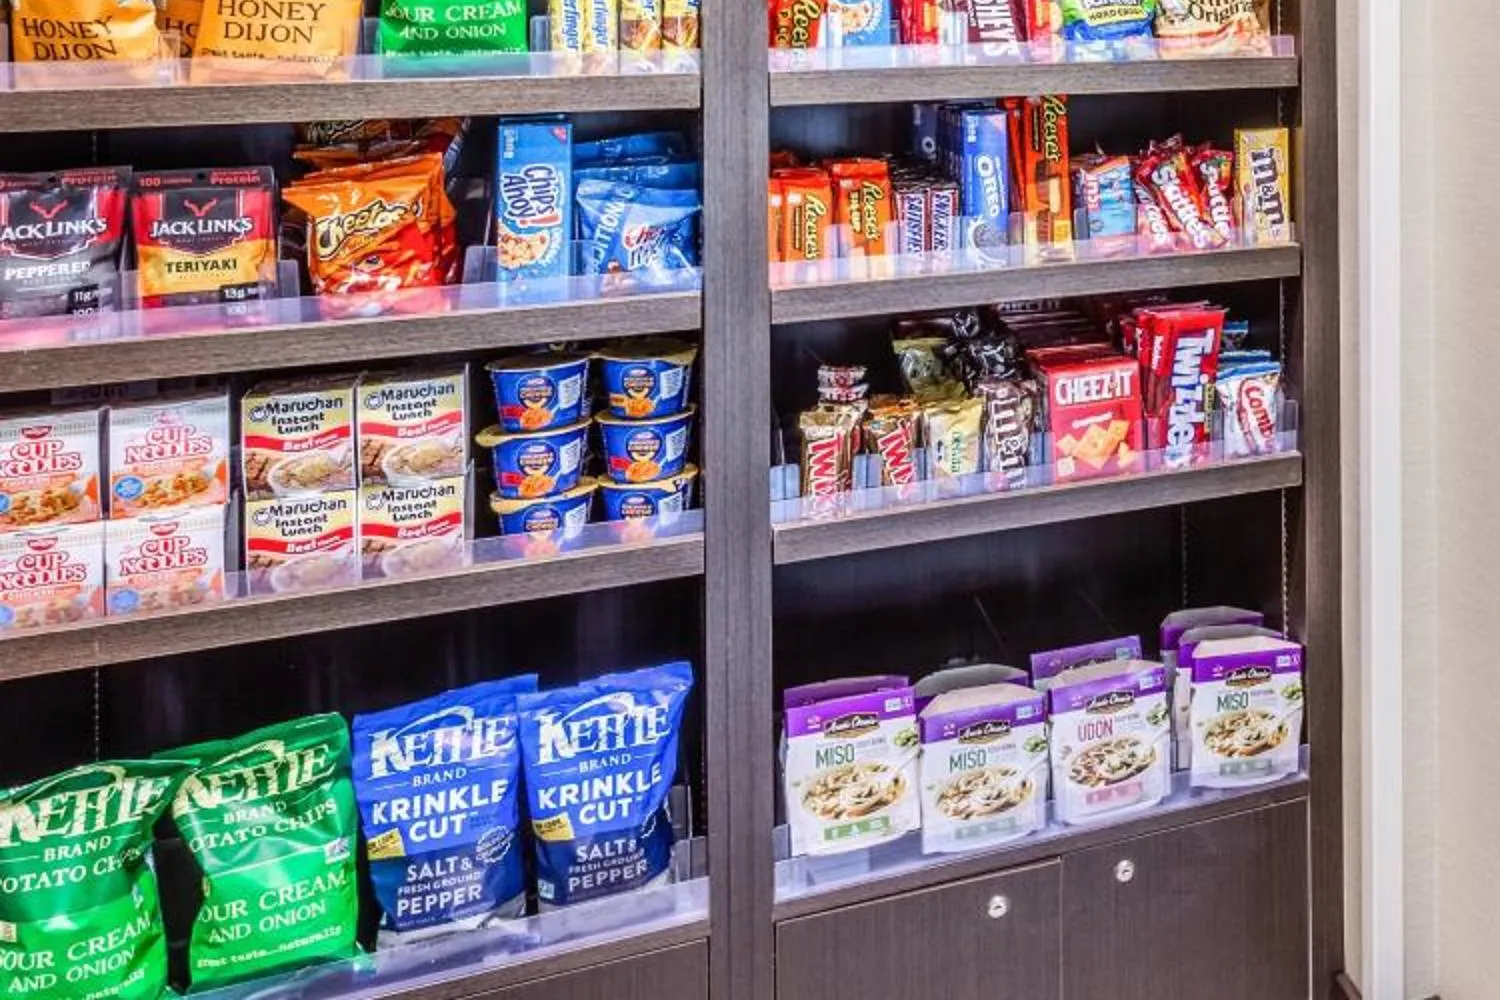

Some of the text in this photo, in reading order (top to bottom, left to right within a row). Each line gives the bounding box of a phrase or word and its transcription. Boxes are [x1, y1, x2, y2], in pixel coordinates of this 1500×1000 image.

[444, 0, 522, 21] CREAM
[22, 14, 114, 40] HONEY
[222, 21, 315, 45] DIJON
[399, 23, 508, 42] AND ONION
[33, 40, 118, 62] DIJON
[210, 173, 262, 186] Protein
[521, 163, 557, 217] Chips
[976, 154, 1000, 219] OREO
[861, 180, 885, 241] Reese's
[46, 216, 108, 237] LINK'S
[150, 216, 254, 238] JACK LINK'S
[805, 193, 827, 260] Reese's
[5, 261, 92, 281] PEPPERED
[164, 257, 238, 275] TERIYAKI
[381, 382, 456, 402] Maruchan
[1054, 369, 1133, 407] CHEEZ-IT
[266, 396, 344, 415] Maruchan
[384, 398, 438, 414] Instant
[391, 409, 433, 422] Lunch
[271, 410, 326, 426] Instant
[277, 423, 320, 436] Lunch
[145, 423, 196, 444] CUP
[11, 439, 63, 460] CUP
[124, 436, 213, 466] NOODLES
[381, 483, 456, 503] Maruchan
[268, 497, 347, 517] Maruchan
[386, 499, 438, 515] Instant
[392, 510, 433, 523] Lunch
[274, 513, 329, 529] Instant
[281, 525, 324, 538] Lunch
[140, 535, 191, 557] CUP
[16, 550, 69, 572] CUP
[119, 547, 209, 577] NOODLES
[1216, 691, 1249, 713] MISO
[534, 690, 674, 767] KETTLE
[1077, 717, 1114, 743] UDON
[367, 705, 517, 782] KETTLE
[578, 751, 633, 774] BRAND
[815, 743, 856, 769] MISO
[949, 749, 988, 773] MISO
[411, 765, 467, 788] BRAND
[537, 764, 663, 810] KRINKLE
[223, 800, 288, 825] BRAND
[372, 778, 509, 826] KRINKLE
[579, 797, 633, 826] CUT
[275, 798, 338, 834] CHIPS
[408, 814, 467, 844] CUT
[43, 835, 112, 863] BRAND
[575, 838, 637, 863] SALT &
[406, 855, 473, 883] SALT &
[568, 848, 645, 876] FRESH GROUND
[397, 871, 482, 896] FRESH GROUND
[568, 859, 648, 893] PEPPER
[258, 870, 347, 911] CREAM
[396, 883, 483, 918] PEPPER
[207, 900, 327, 944] AND ONION
[67, 911, 151, 961] CREAM
[7, 974, 57, 994] AND
[66, 948, 136, 983] ONION
